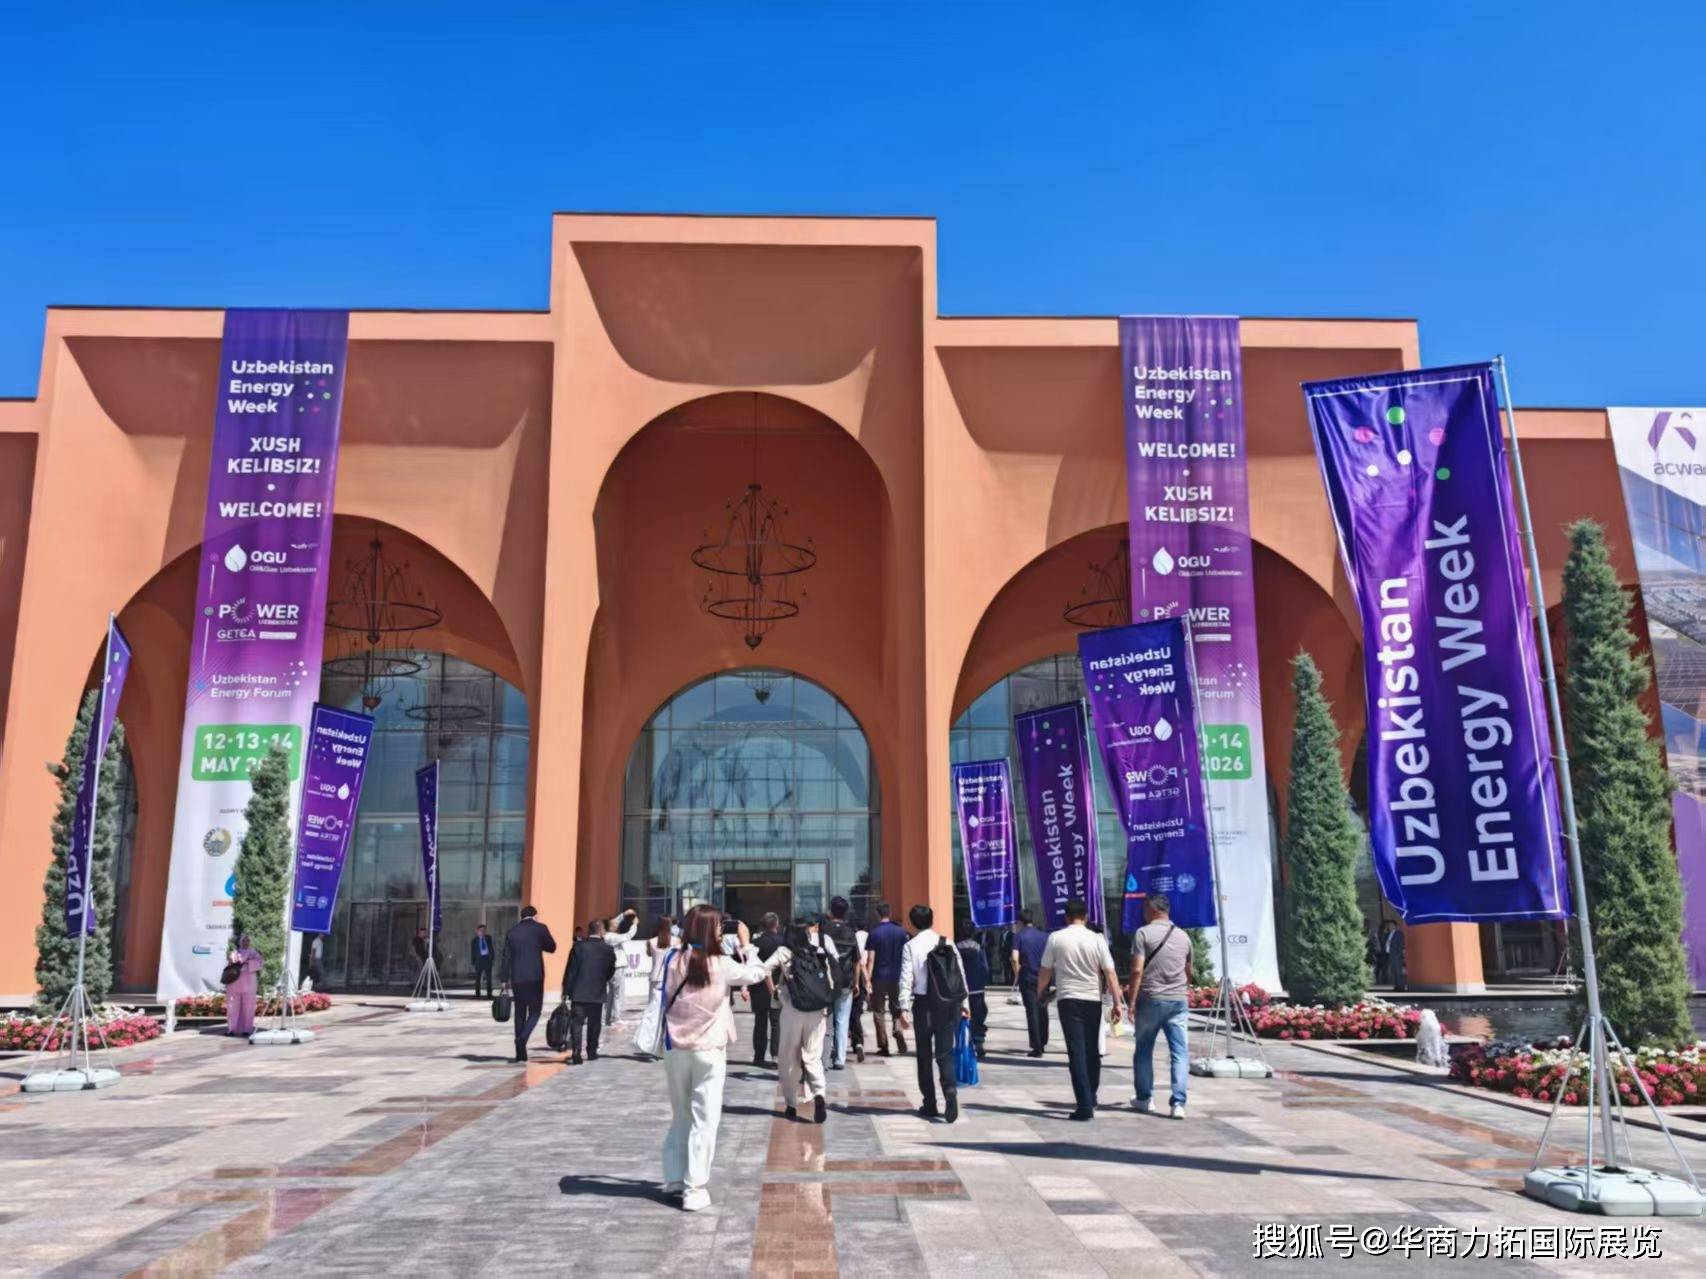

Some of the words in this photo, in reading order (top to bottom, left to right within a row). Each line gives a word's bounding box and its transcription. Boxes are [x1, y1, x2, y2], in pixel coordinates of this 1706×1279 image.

[231, 360, 333, 374] Uzbekistan
[1134, 366, 1232, 381] Uzbekistan
[229, 380, 294, 396] Energy
[1135, 386, 1195, 403] Energy
[228, 399, 278, 413] Week
[1135, 405, 1183, 420] Week
[250, 437, 301, 452] XUSH
[1138, 442, 1235, 458] WELCOME!
[227, 458, 320, 474] KELIBSIZ!
[1164, 486, 1212, 501] XUSH
[219, 502, 322, 518] WELCOME!
[1145, 507, 1234, 523] KELIBSIZ!
[251, 551, 287, 564] OGU
[1178, 556, 1210, 567] OGU
[1424, 514, 1489, 672] Week
[212, 675, 277, 684] Uzbekistan
[211, 688, 249, 699] Energy
[253, 688, 292, 697] Forum
[1377, 576, 1446, 885] Uzbekistan
[200, 756, 241, 773] MAY
[1457, 683, 1520, 883] Energy
[1058, 763, 1076, 828] Week
